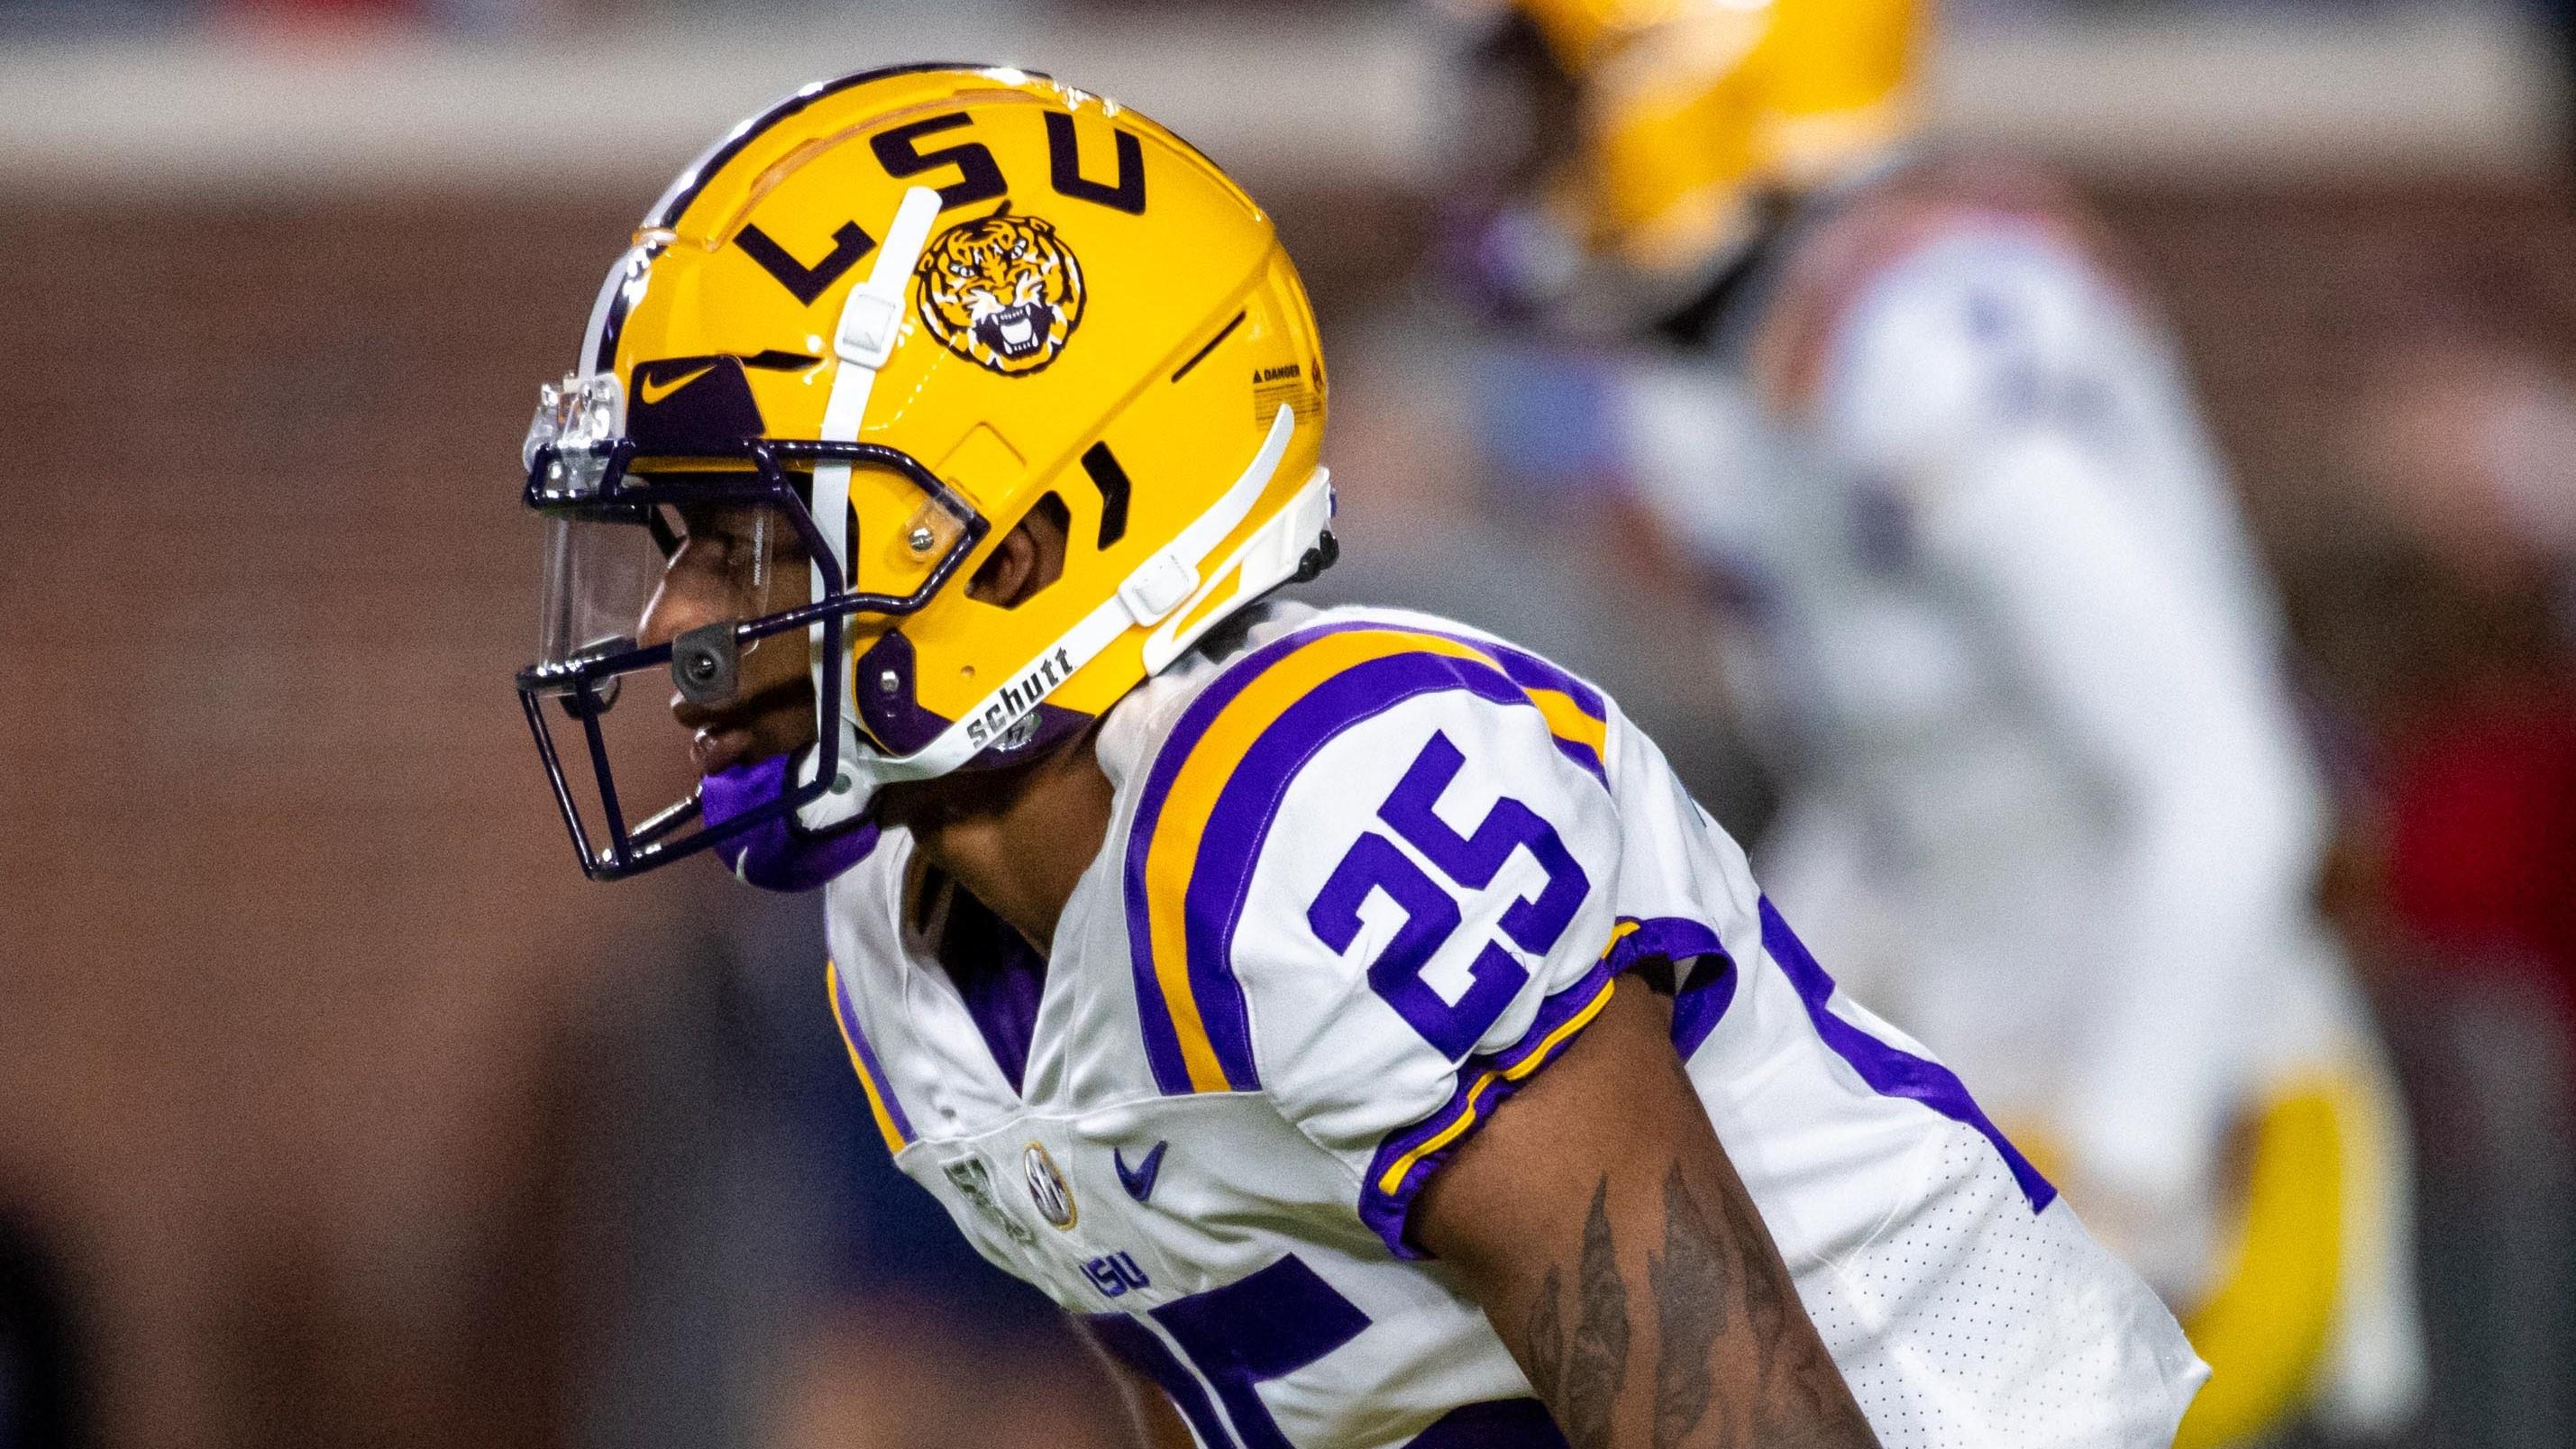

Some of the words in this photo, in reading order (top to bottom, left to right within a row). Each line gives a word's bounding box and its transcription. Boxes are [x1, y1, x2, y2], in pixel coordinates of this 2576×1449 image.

[733, 111, 1146, 308] LSU
[1264, 364, 1301, 381] DANGER
[966, 646, 1073, 749] schutt
[1306, 728, 1591, 1065] 25
